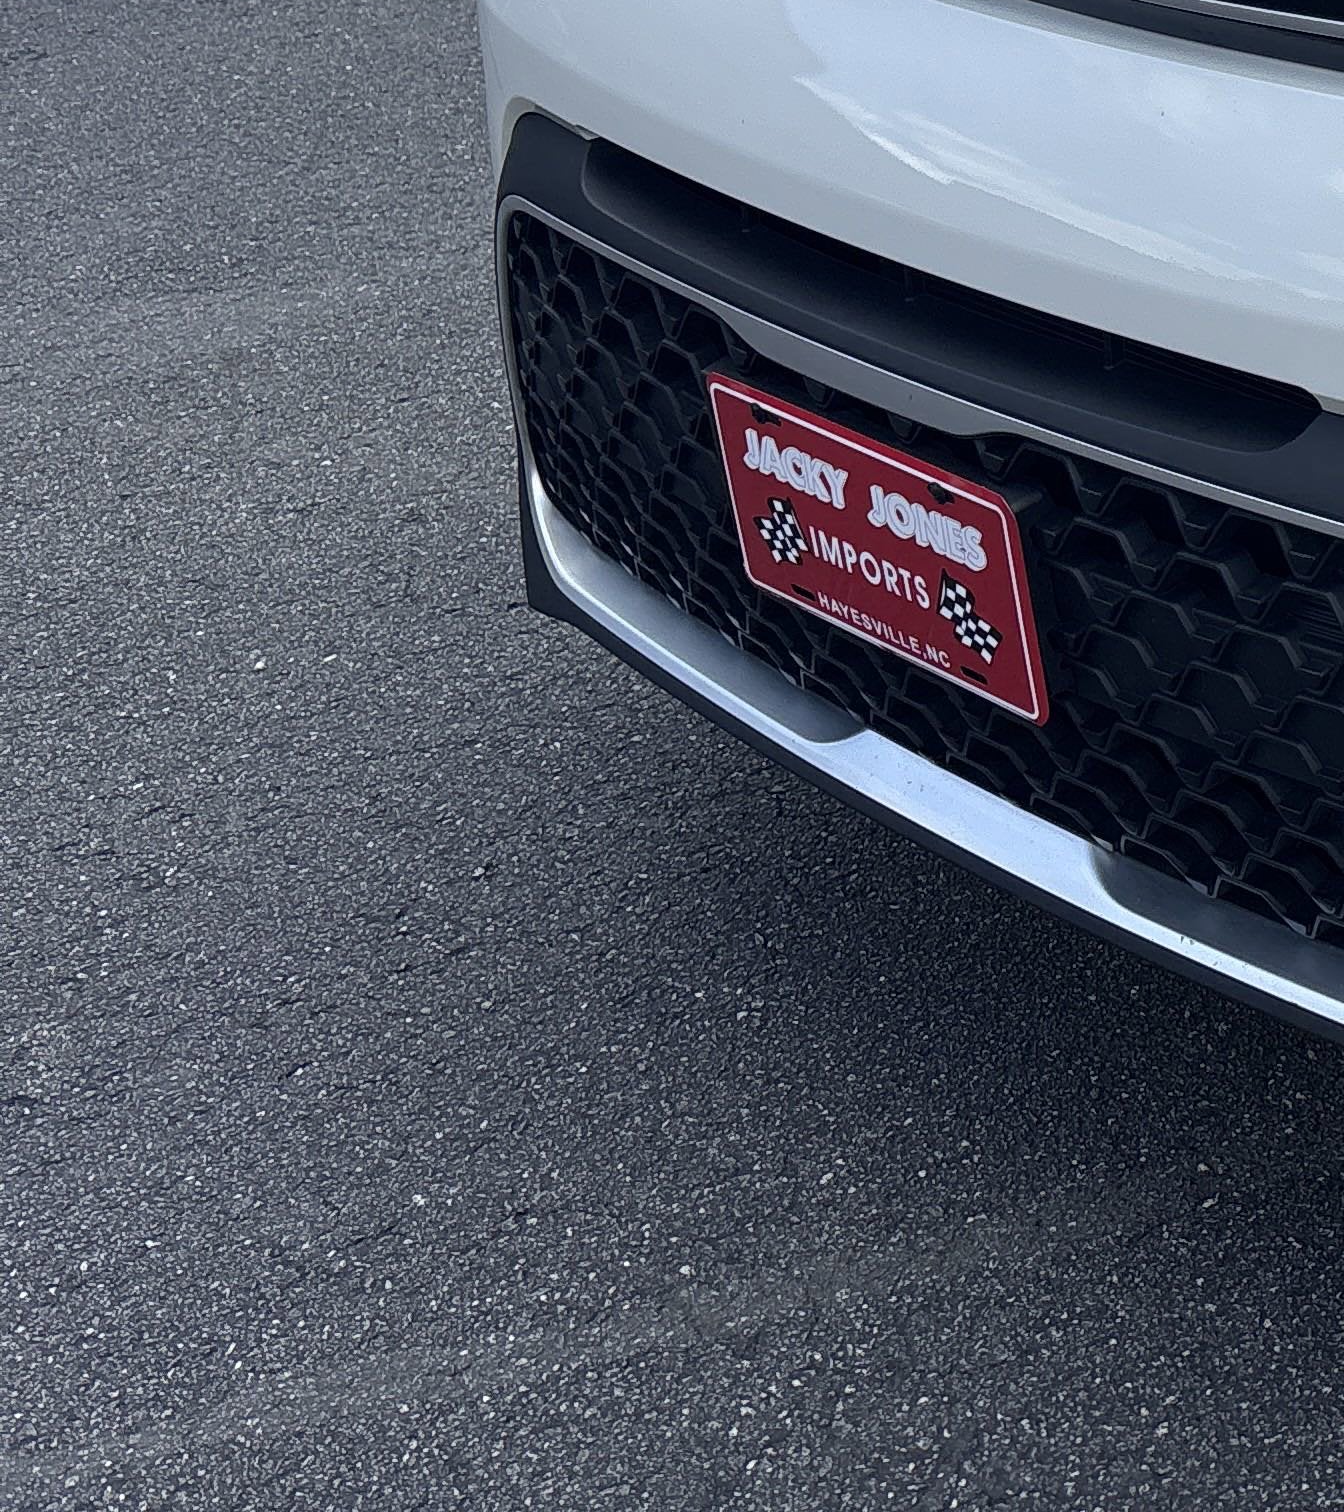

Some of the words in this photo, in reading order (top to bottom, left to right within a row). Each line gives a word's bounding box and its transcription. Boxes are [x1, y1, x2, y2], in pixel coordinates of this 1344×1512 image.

[743, 428, 849, 510] JACKY
[866, 484, 988, 572] JONES
[808, 526, 931, 609] IMPORTS
